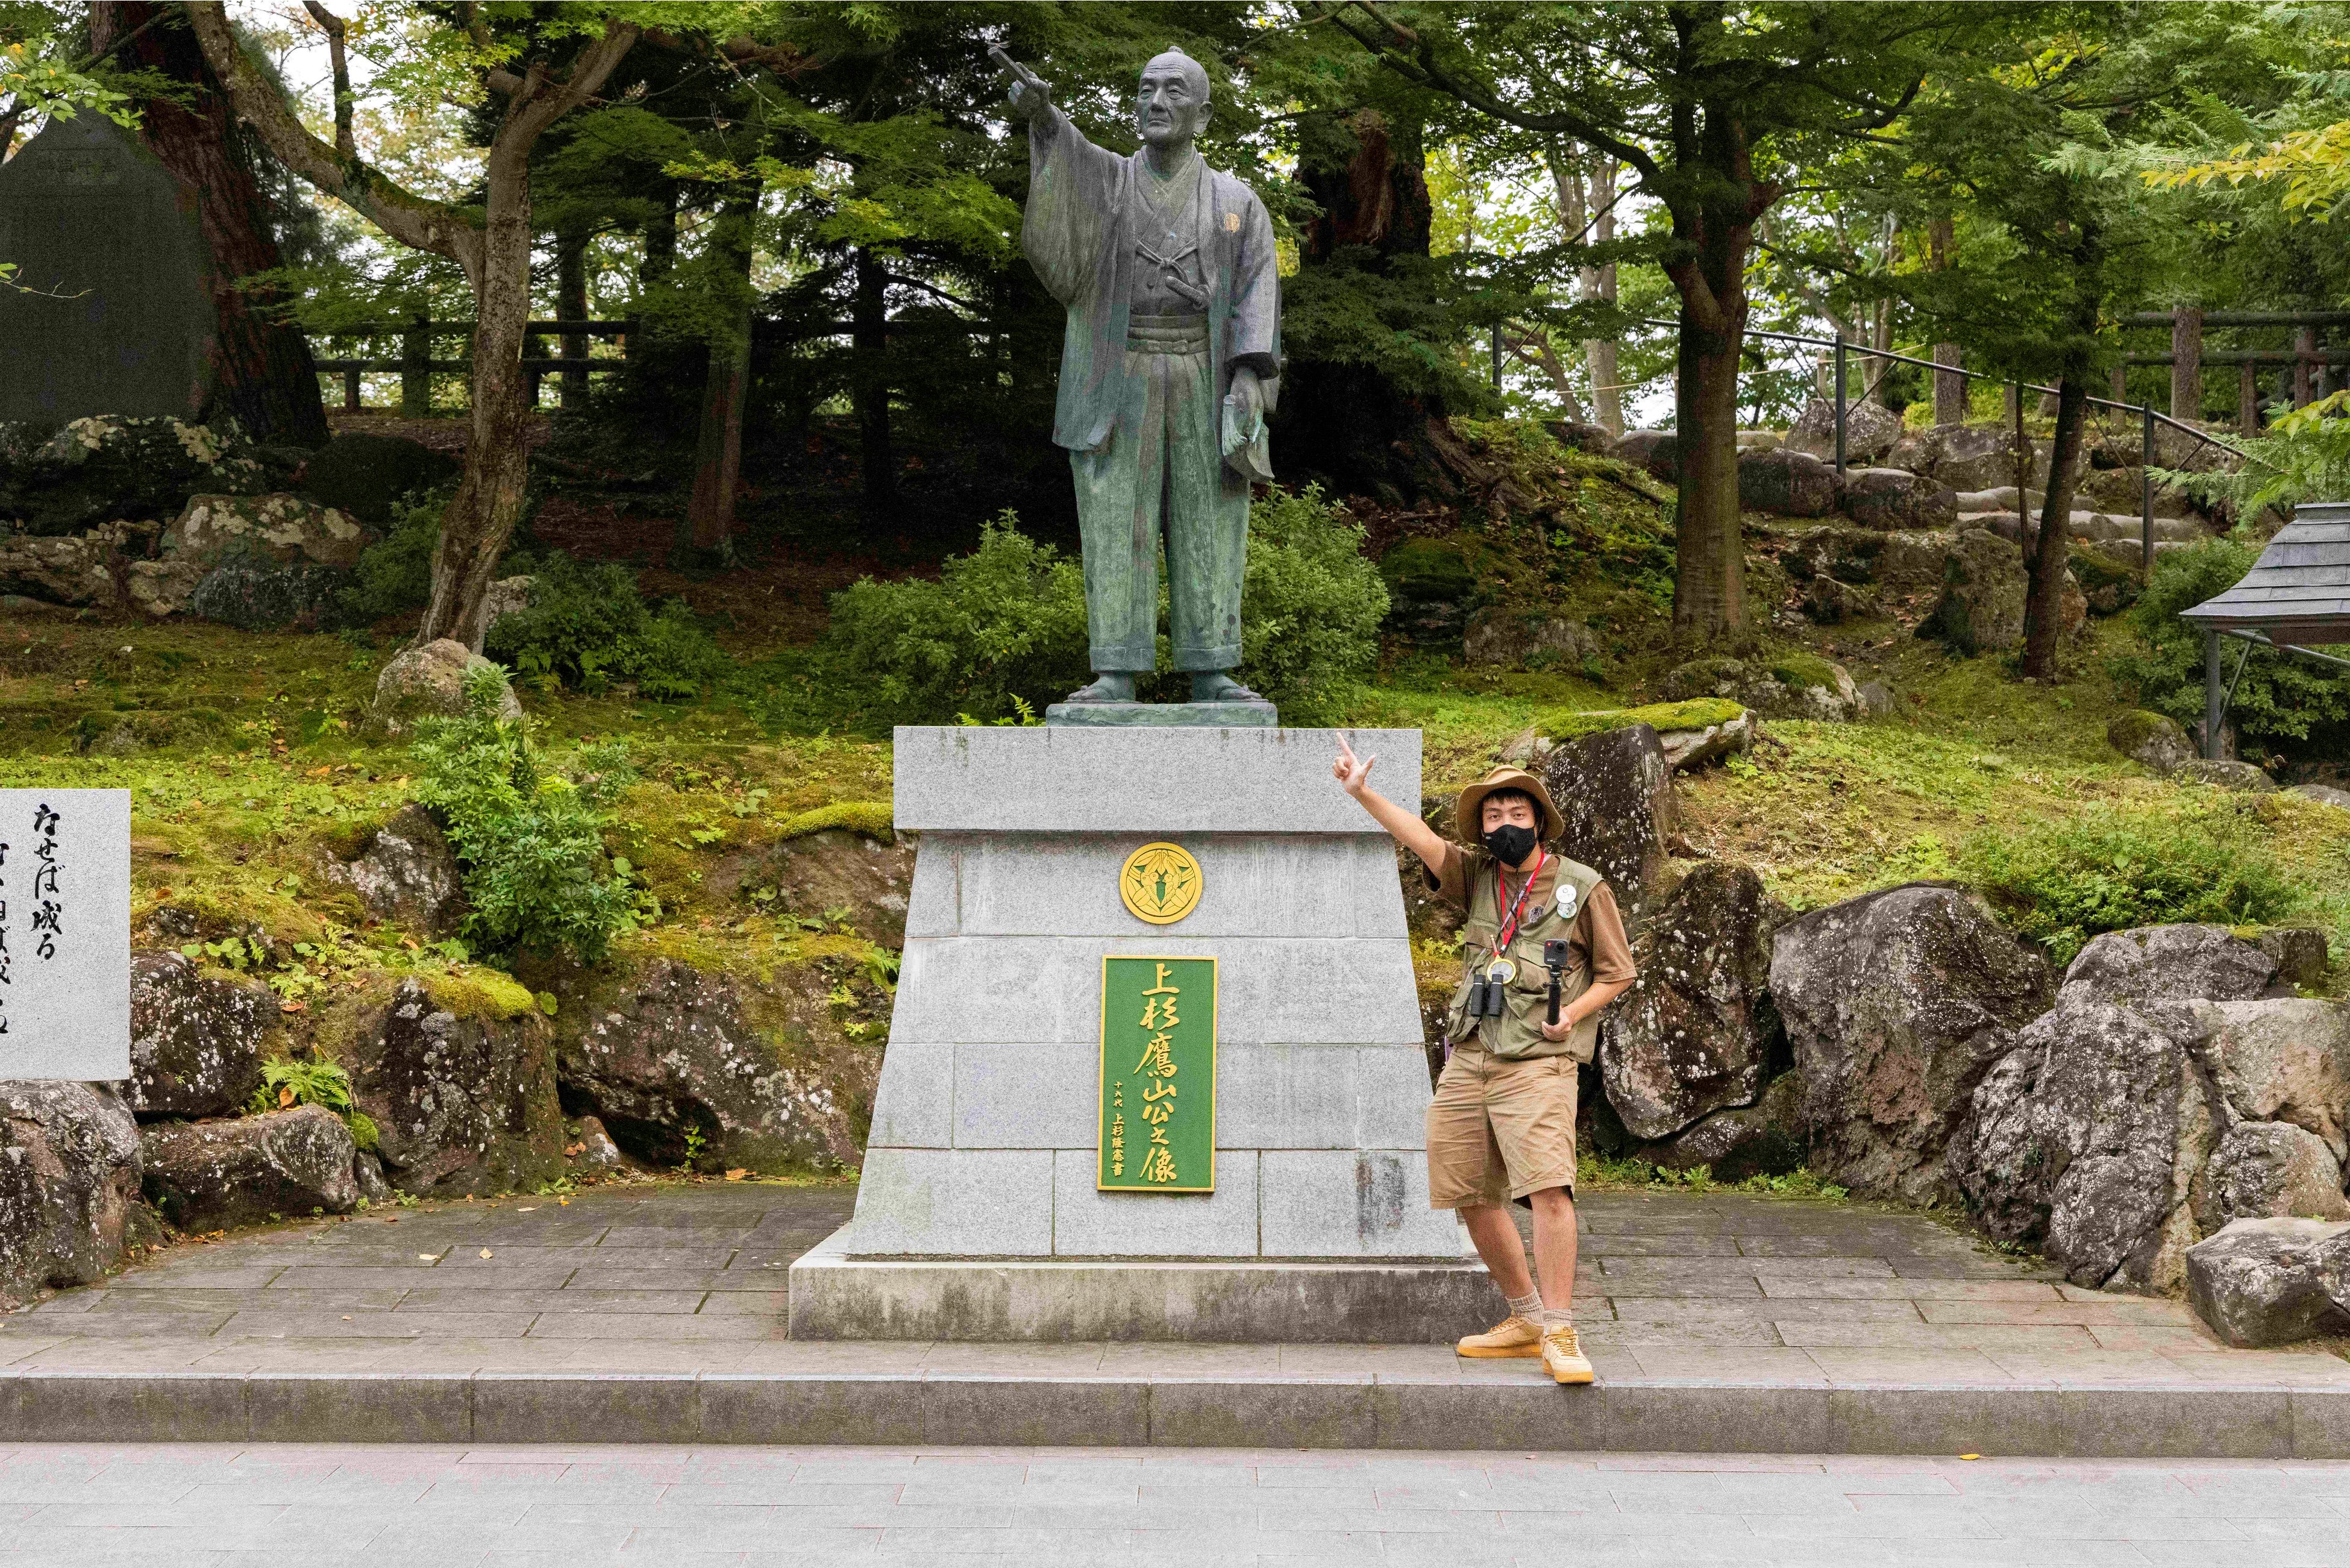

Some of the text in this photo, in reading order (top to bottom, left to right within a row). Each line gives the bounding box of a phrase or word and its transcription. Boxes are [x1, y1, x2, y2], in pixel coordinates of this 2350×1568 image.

[30, 803, 65, 961] なせば成る
[1133, 962, 1179, 1182] 上杉鷹山公之像
